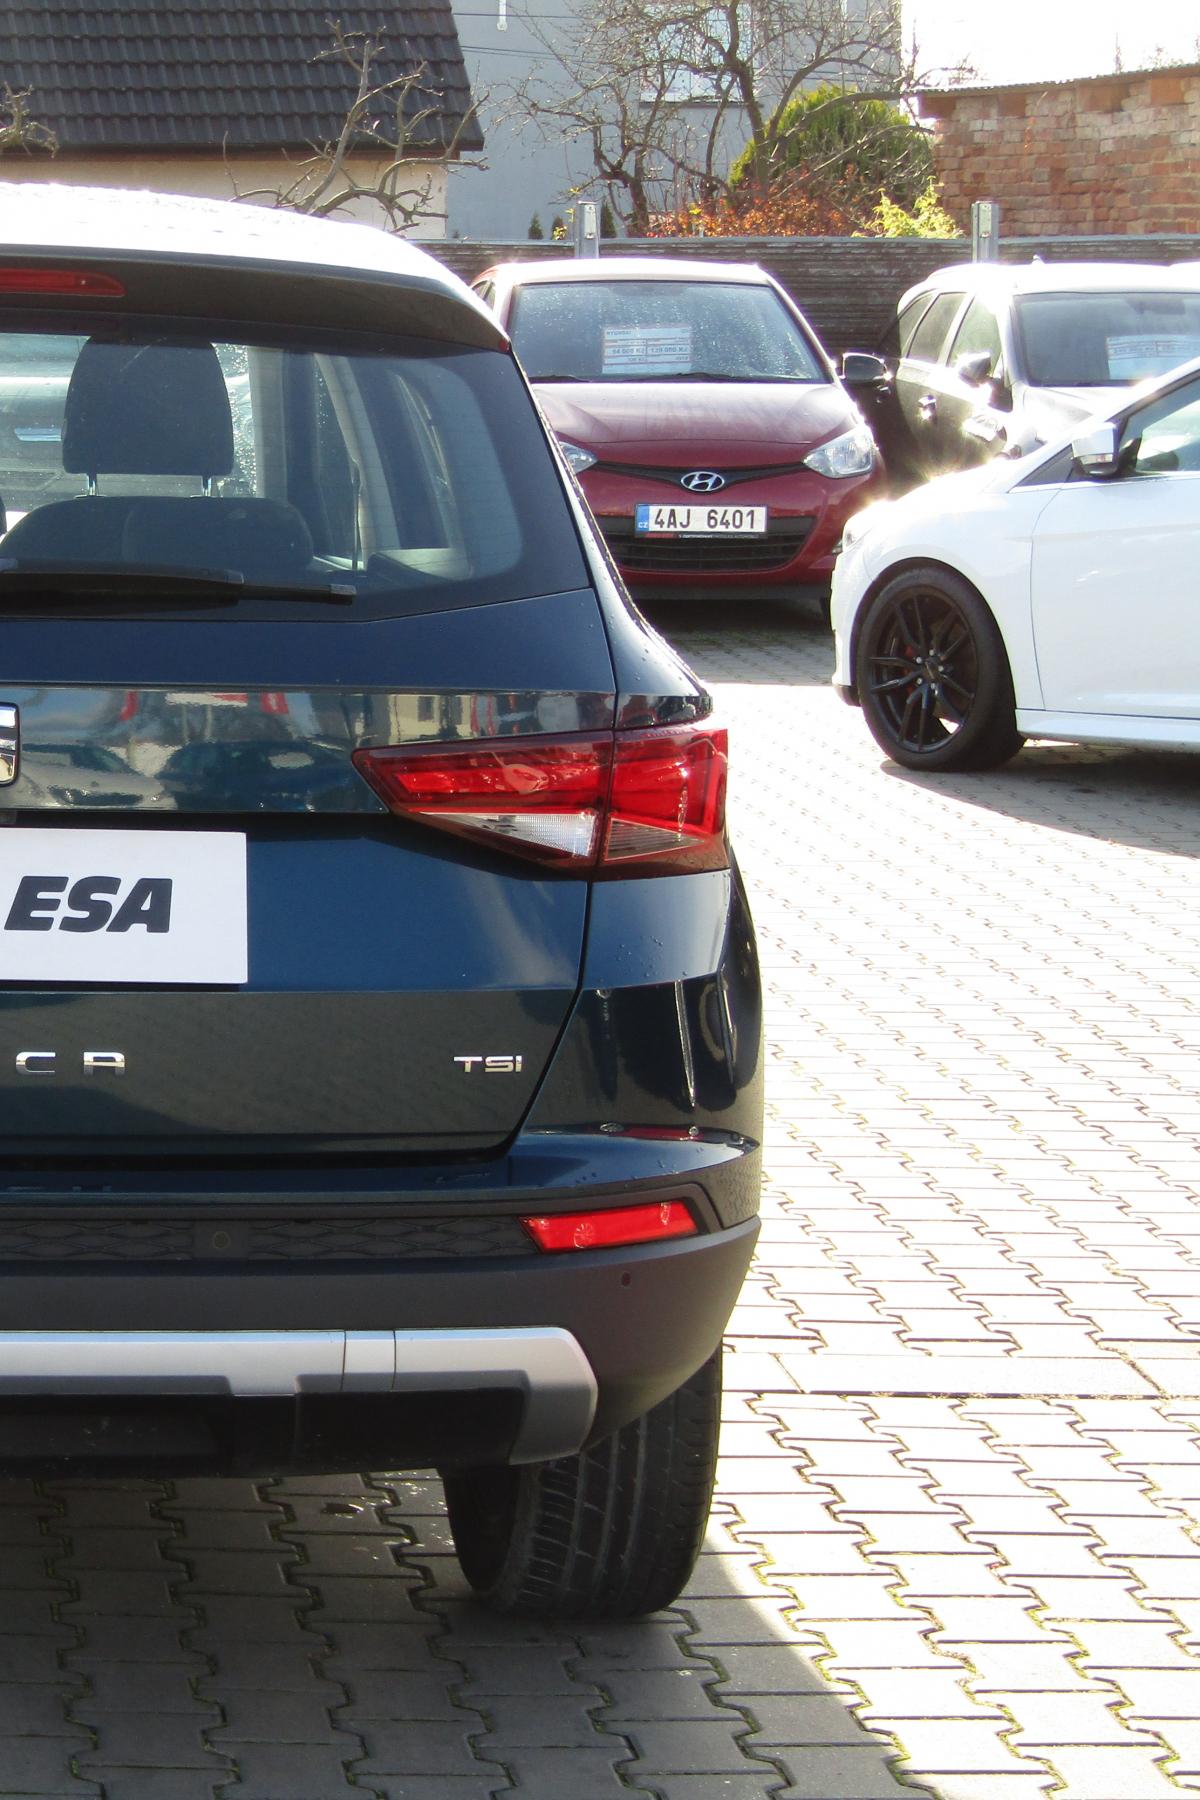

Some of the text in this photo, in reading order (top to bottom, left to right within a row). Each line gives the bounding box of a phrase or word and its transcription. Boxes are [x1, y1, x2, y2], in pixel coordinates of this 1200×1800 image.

[638, 521, 648, 529] CZ
[654, 508, 756, 530] 4AJ 6401
[4, 875, 173, 933] ESA
[453, 1055, 522, 1073] TSI
